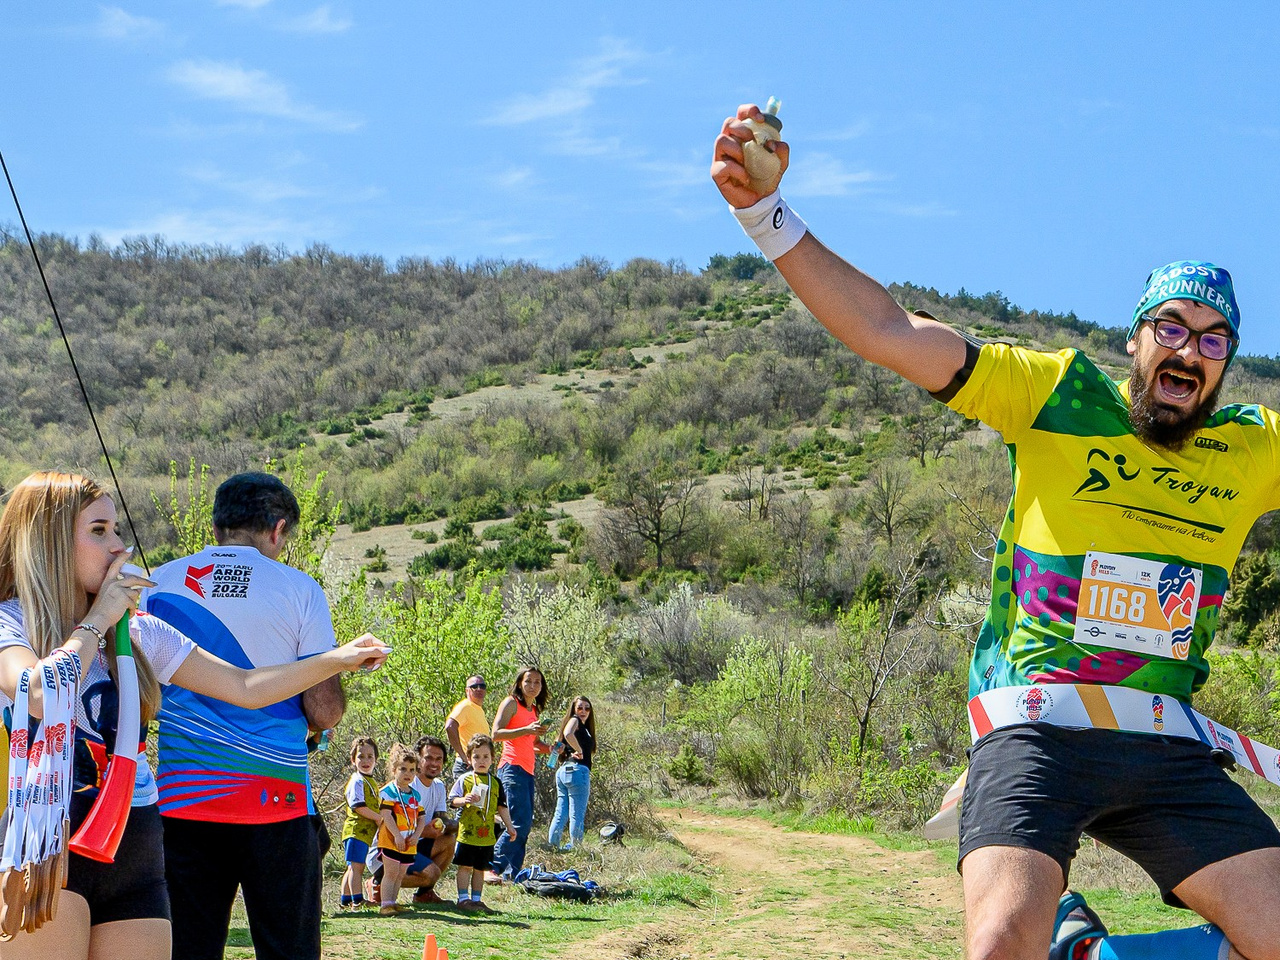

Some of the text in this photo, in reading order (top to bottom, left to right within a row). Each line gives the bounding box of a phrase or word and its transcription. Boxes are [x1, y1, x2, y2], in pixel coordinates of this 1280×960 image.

[1158, 280, 1232, 317] RUNNERS
[1151, 467, 1240, 504] Troyan
[212, 585, 248, 594] 2022
[1088, 584, 1146, 623] 1168
[43, 665, 56, 690] EVERY
[55, 661, 67, 688] EVERY
[62, 658, 75, 683] EVERY
